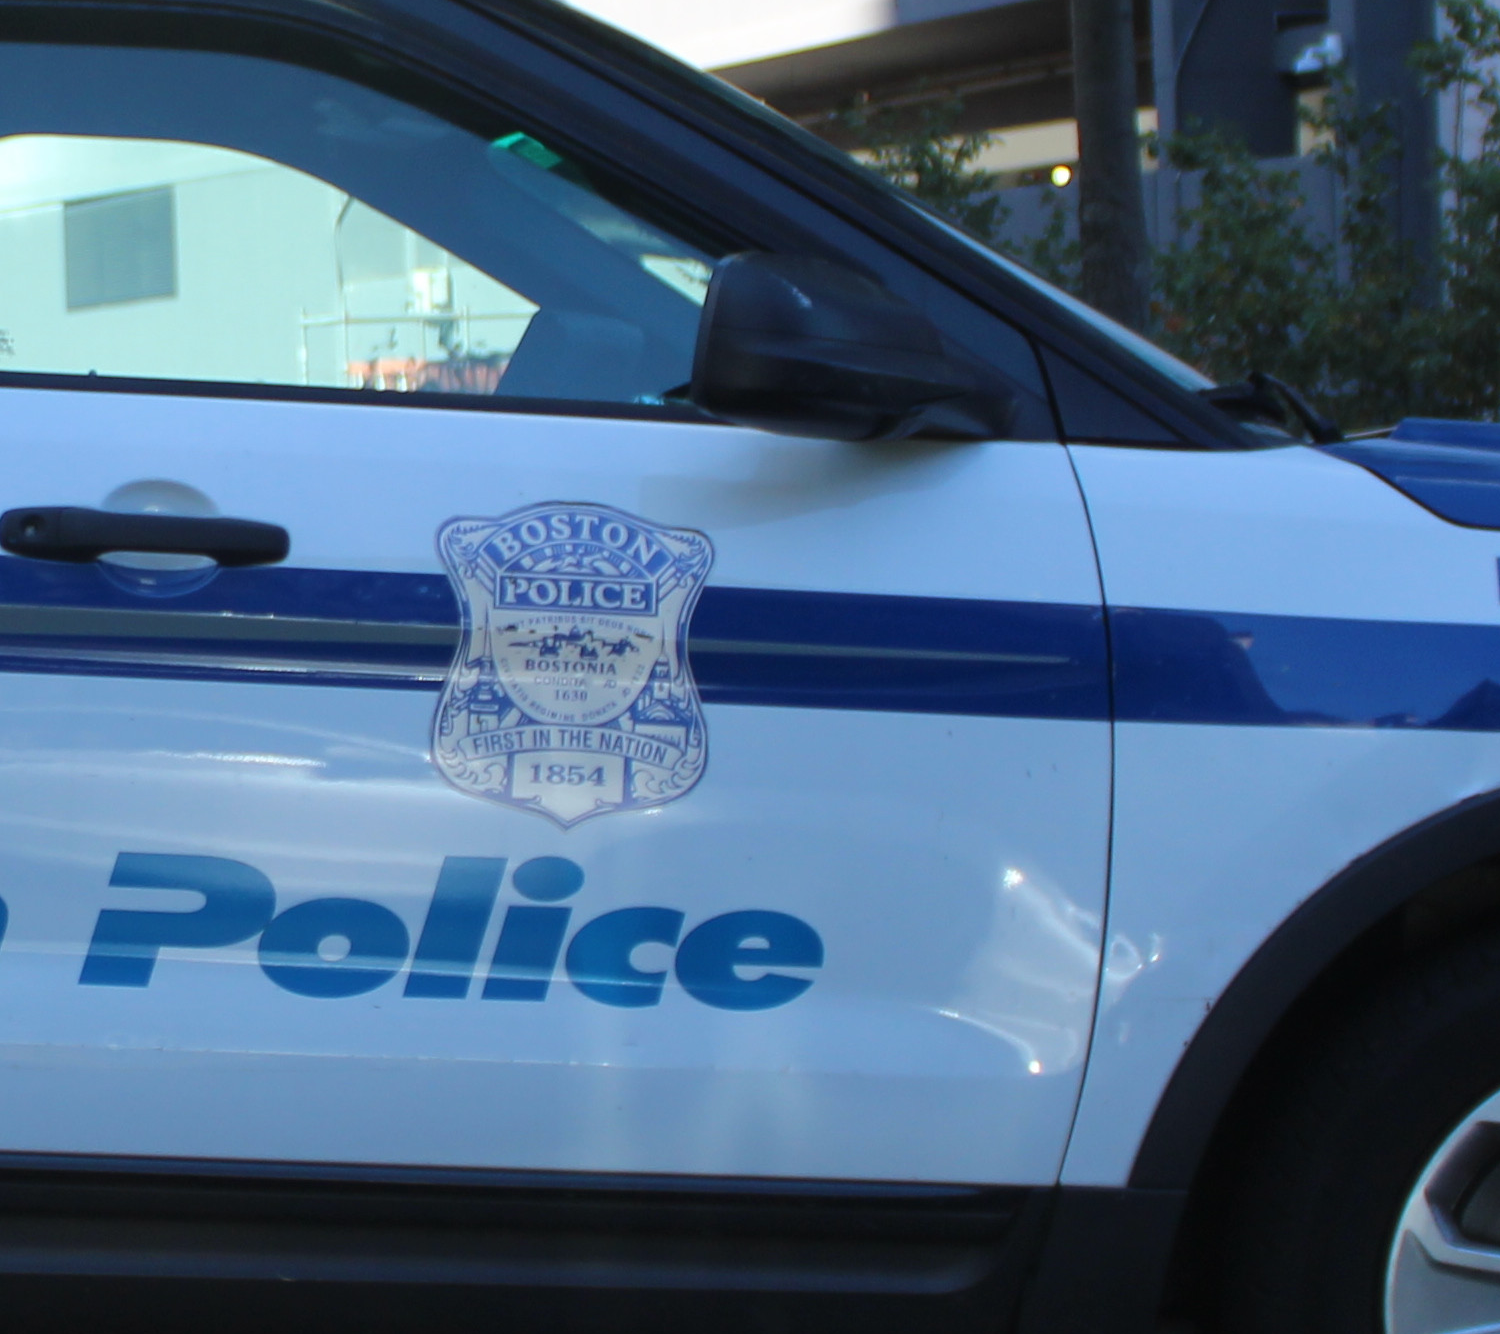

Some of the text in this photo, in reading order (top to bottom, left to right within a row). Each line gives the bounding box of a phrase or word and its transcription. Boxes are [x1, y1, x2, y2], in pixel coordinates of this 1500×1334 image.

[492, 514, 660, 566] BOSTON
[503, 577, 648, 610] POLICE
[525, 659, 617, 676] BOSTONIA
[554, 689, 589, 702] 1630
[472, 729, 669, 765] FIRST IN THE NATION
[528, 764, 607, 787] 1854
[77, 851, 825, 1012] Police
